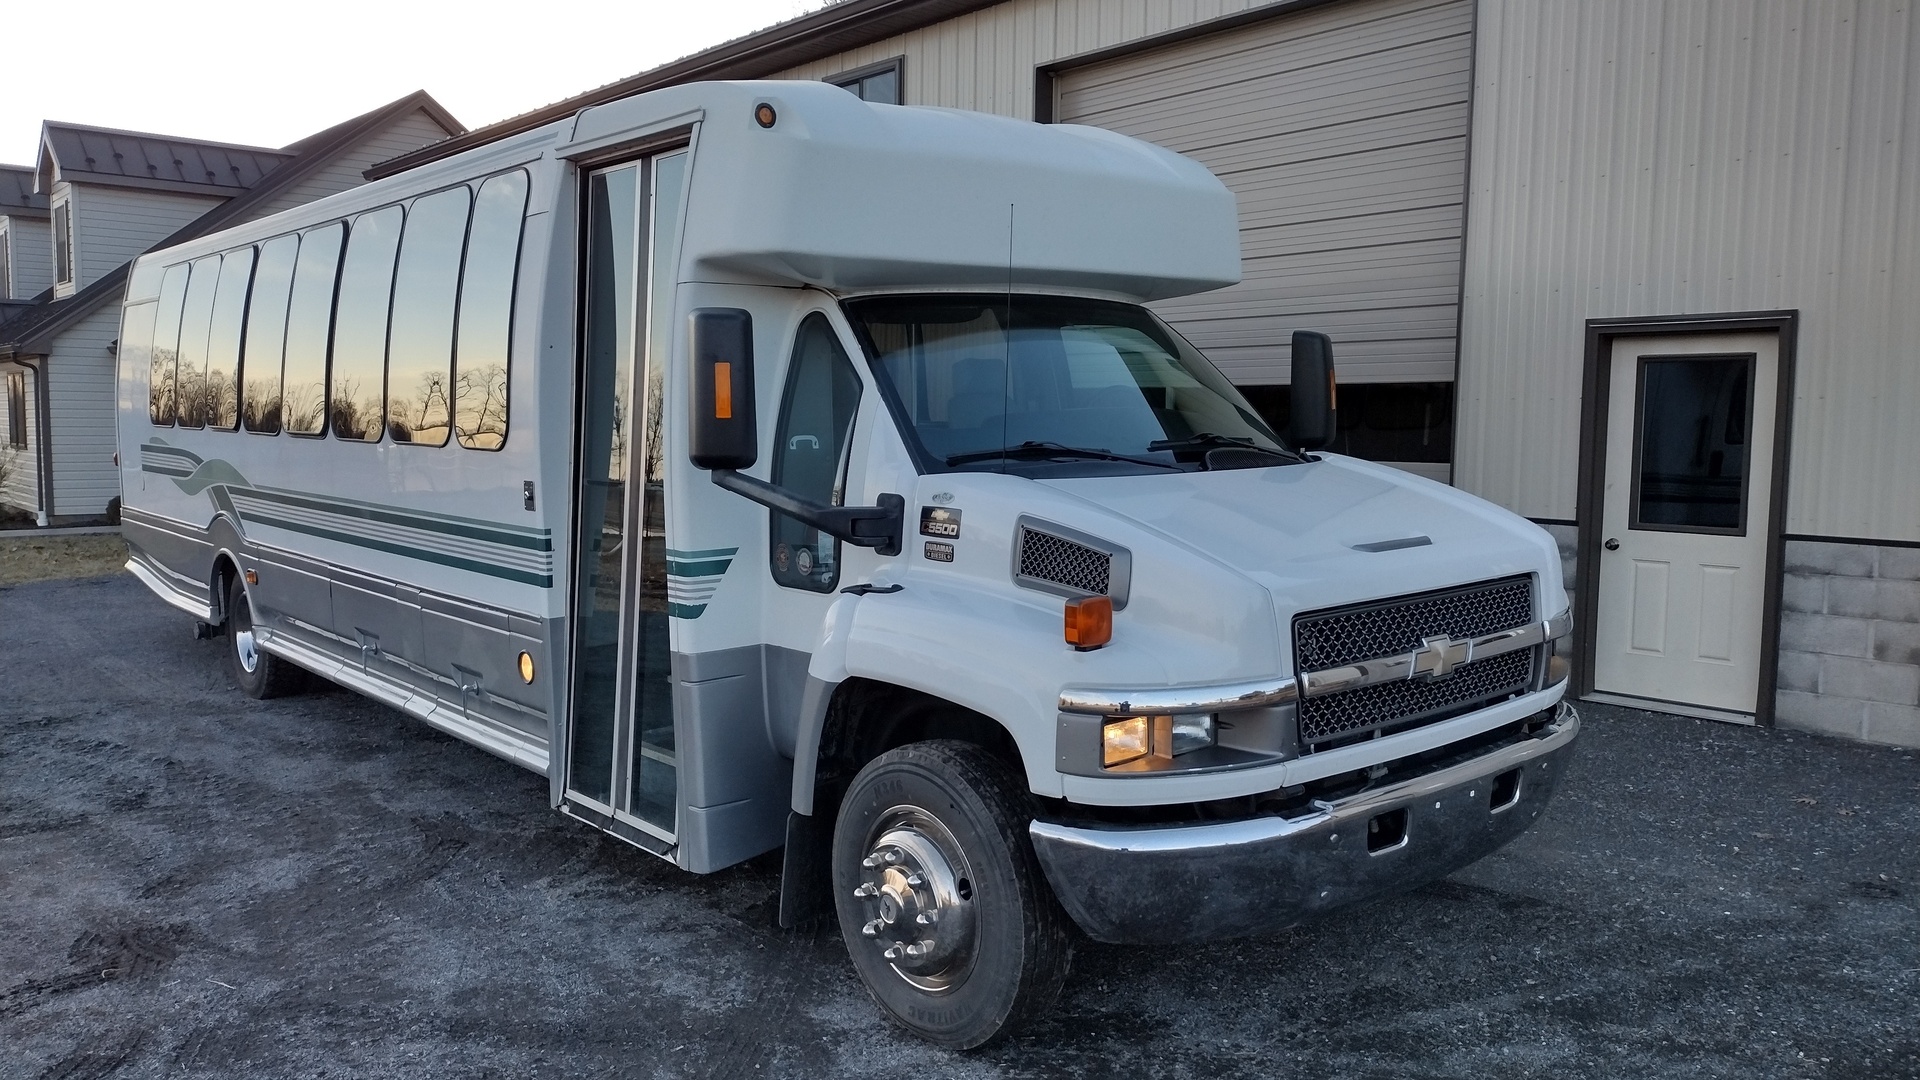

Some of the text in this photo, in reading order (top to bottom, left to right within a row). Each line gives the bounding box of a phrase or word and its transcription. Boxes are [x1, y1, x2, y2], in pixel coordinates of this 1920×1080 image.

[922, 522, 958, 535] C5500
[926, 543, 953, 554] DURAMAX
[930, 552, 947, 560] DIESEL
